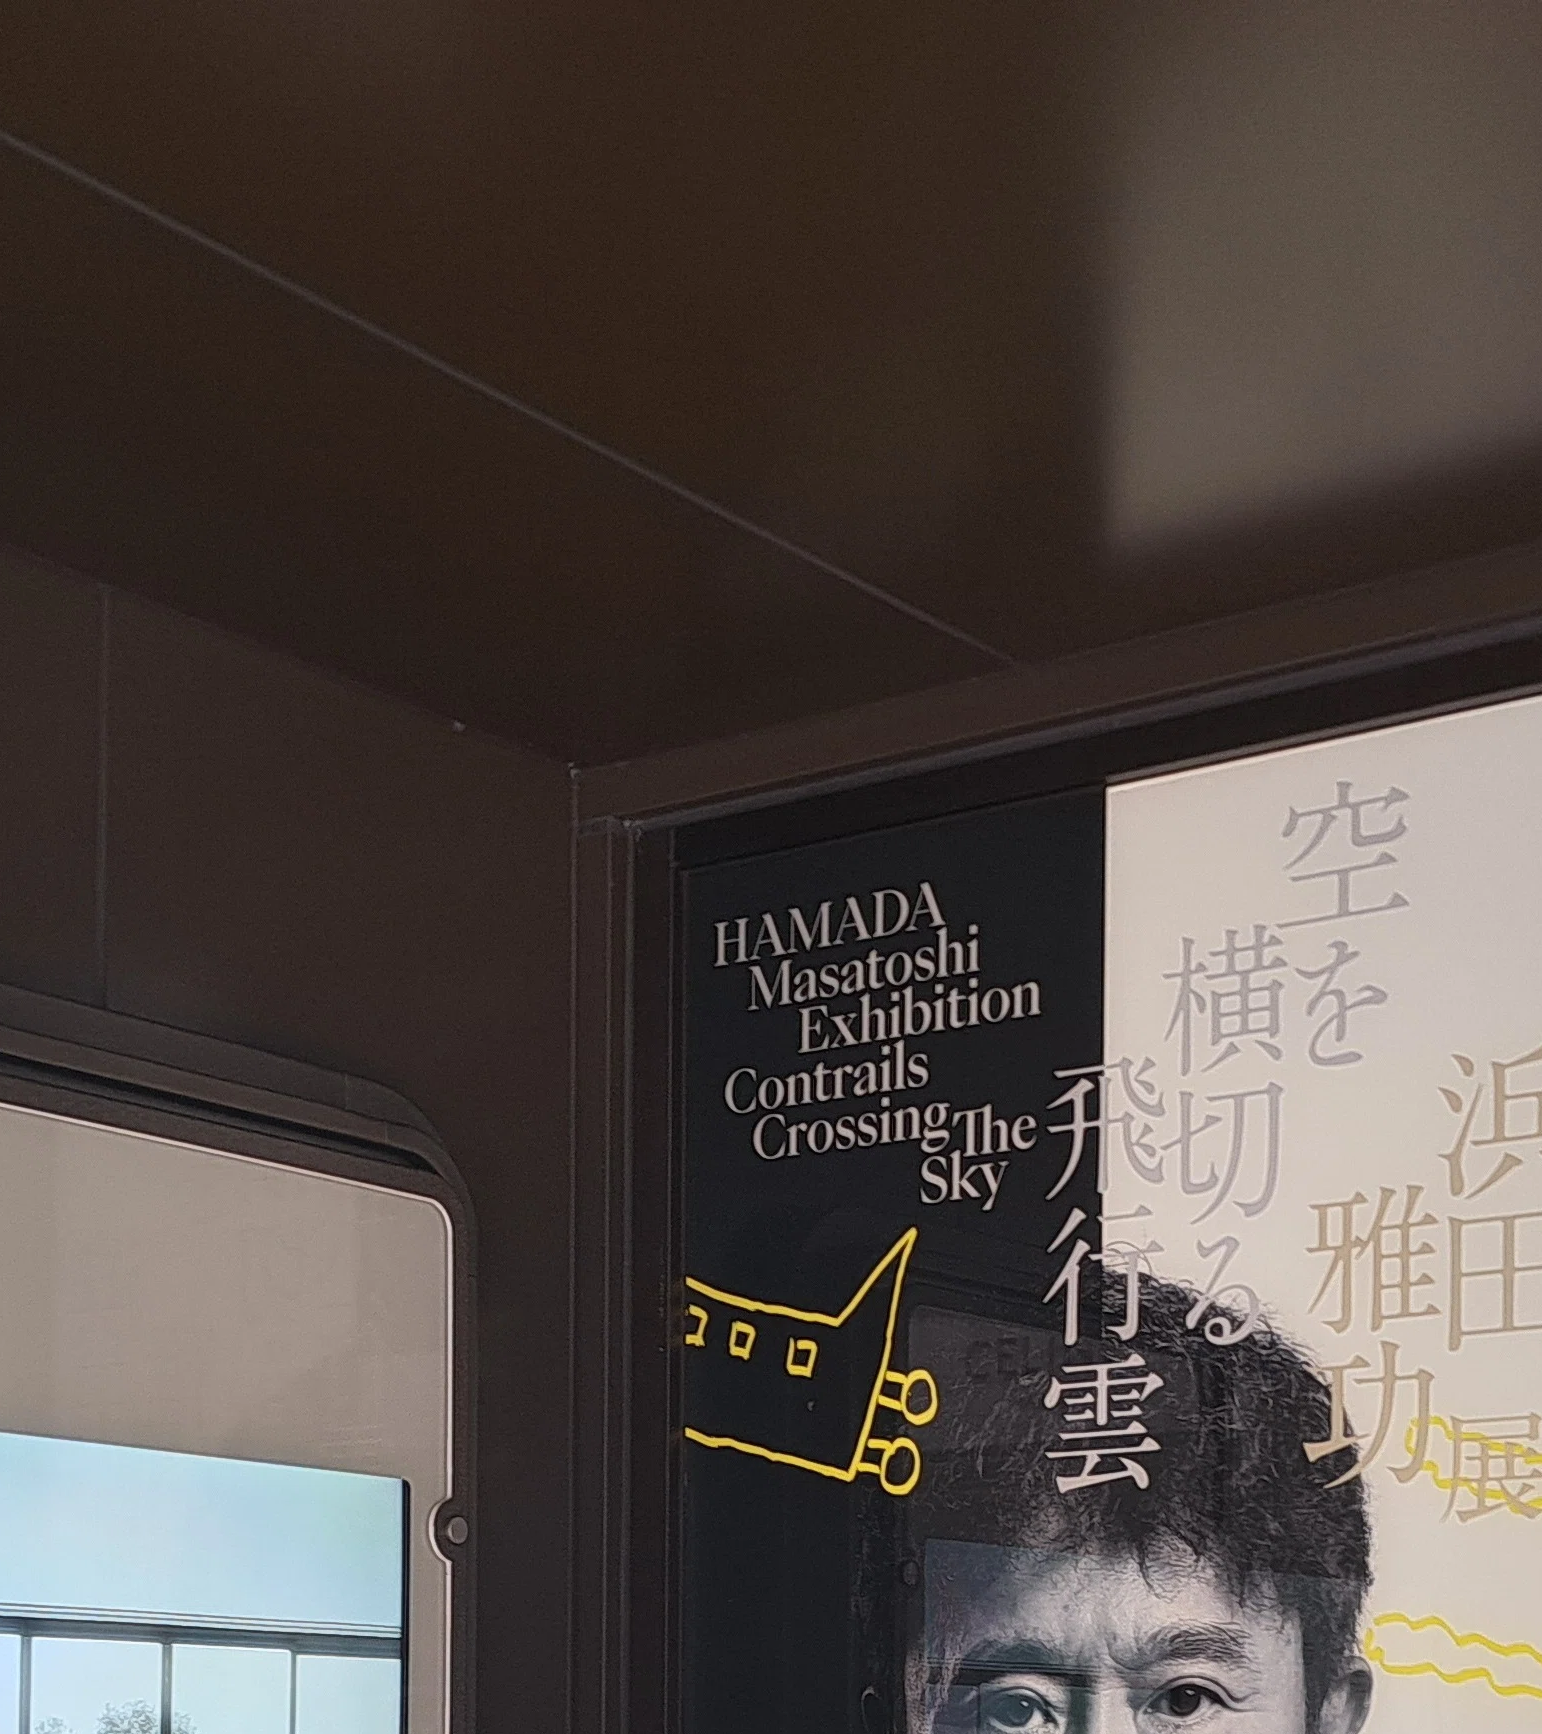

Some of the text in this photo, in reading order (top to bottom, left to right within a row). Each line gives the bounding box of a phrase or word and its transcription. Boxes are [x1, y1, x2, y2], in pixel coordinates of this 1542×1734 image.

[713, 882, 946, 967] HAMADA
[1277, 780, 1411, 1068] 空を
[747, 924, 980, 1011] Masatoshi
[798, 978, 1041, 1054] Exhibition
[725, 1040, 929, 1114] Contrails
[752, 1098, 1038, 1160] Crossing The
[1161, 924, 1288, 1345] 横切る
[920, 1150, 1009, 1210] Sky
[1042, 1055, 1166, 1494] 飛行雲
[1302, 1184, 1442, 1490] 雅功
